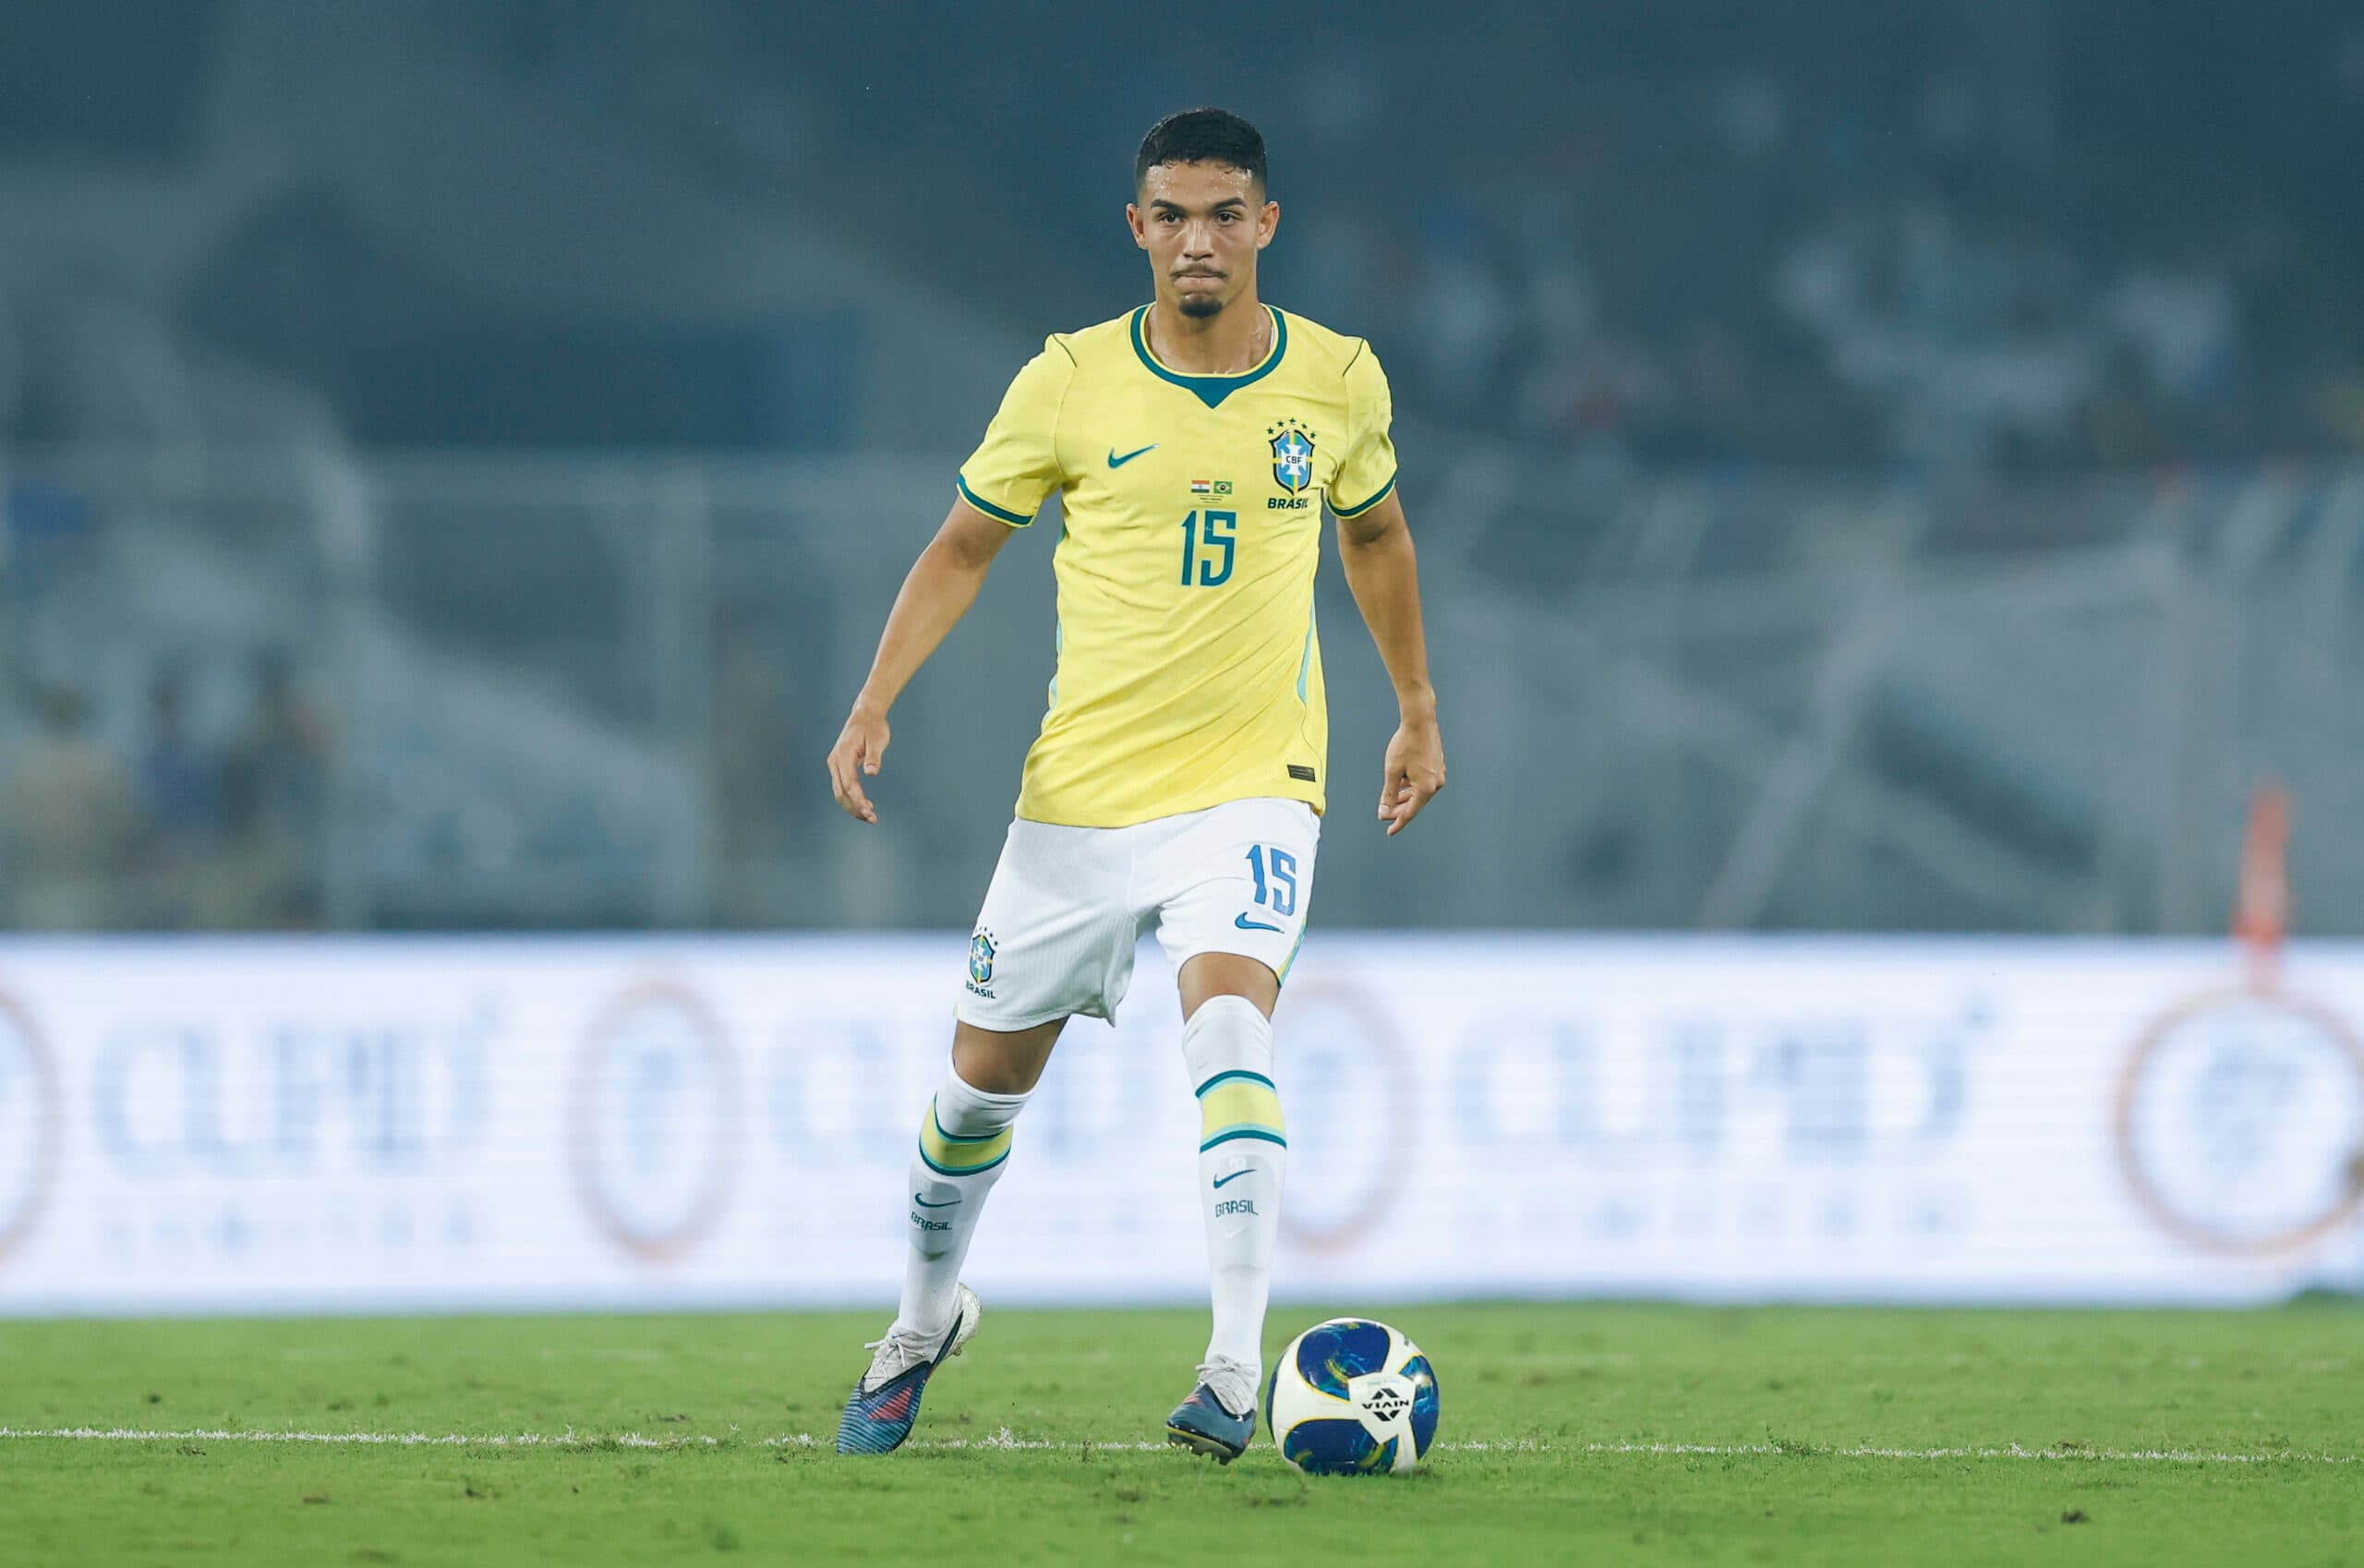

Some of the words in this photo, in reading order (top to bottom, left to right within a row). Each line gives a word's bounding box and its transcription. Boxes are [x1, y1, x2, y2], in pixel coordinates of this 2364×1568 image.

[1285, 455, 1302, 464] CBF
[1267, 497, 1309, 509] BRASIL
[1181, 510, 1236, 586] 15
[1245, 844, 1297, 916] 15
[965, 980, 996, 999] BRASIL
[1215, 1200, 1260, 1218] BRASIL
[911, 1211, 953, 1231] BRASIL
[1361, 1399, 1409, 1409] NIVIA
